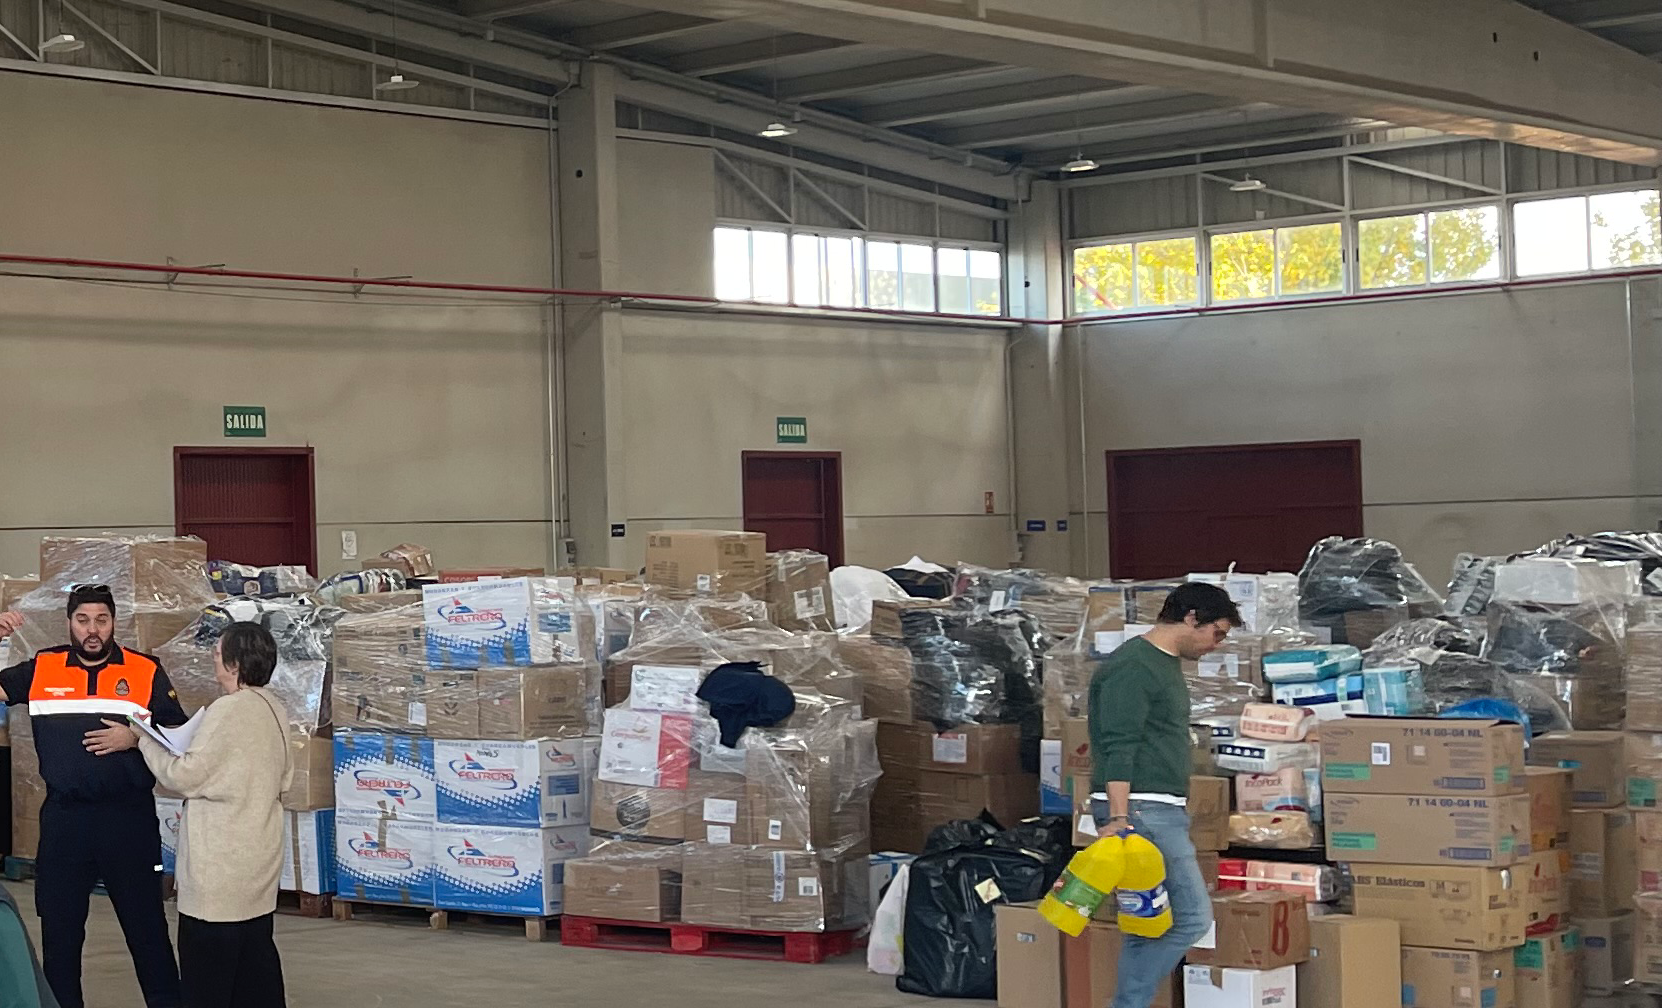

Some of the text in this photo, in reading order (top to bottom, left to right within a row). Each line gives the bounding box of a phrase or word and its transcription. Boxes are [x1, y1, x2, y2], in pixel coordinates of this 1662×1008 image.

[226, 413, 264, 429] SALIDA
[778, 423, 806, 437] SALIDA
[1402, 727, 1415, 737] 71
[1419, 727, 1431, 737] 14
[1467, 729, 1484, 738] NL
[1407, 798, 1421, 807] 71
[1424, 798, 1437, 808] 14
[1473, 800, 1489, 809] NL
